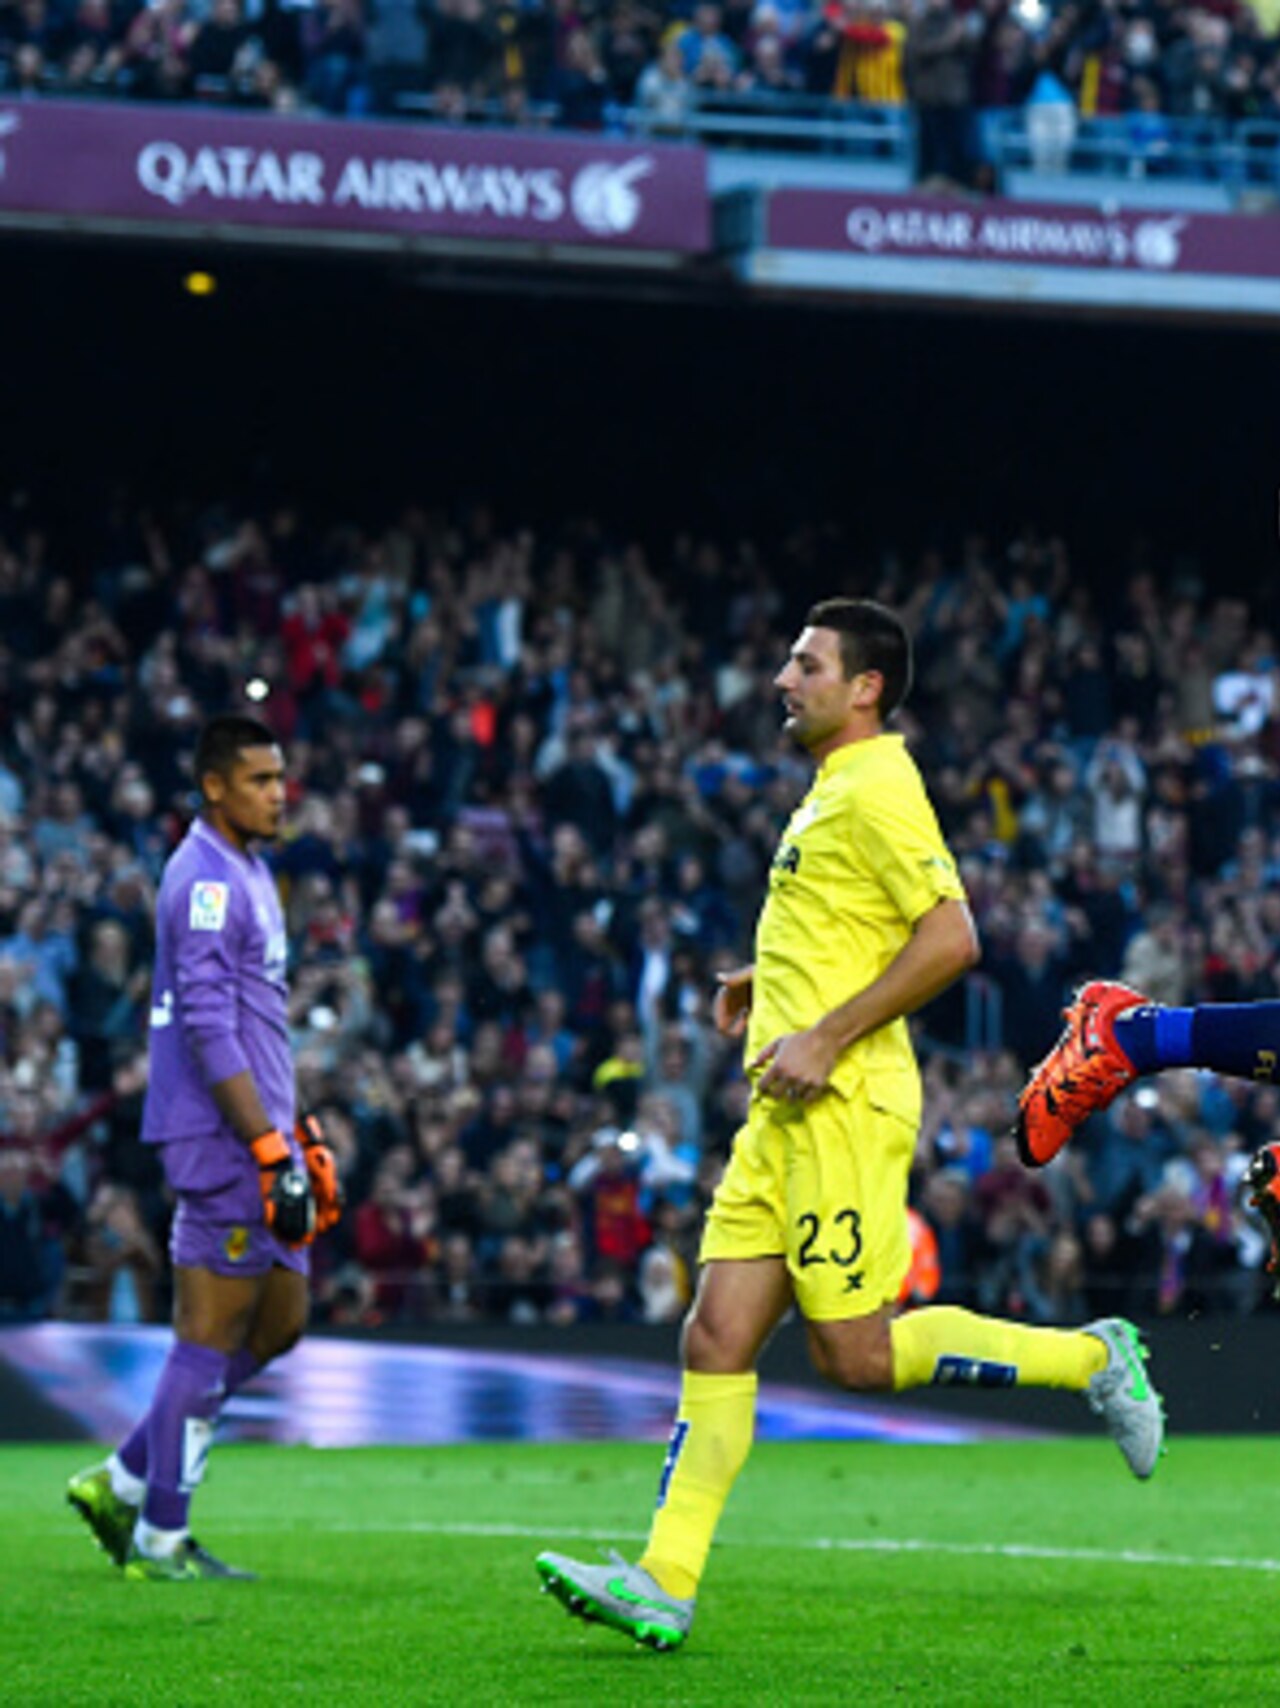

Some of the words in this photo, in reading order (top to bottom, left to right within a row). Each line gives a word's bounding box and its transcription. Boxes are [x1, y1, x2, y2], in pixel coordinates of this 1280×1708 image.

[137, 141, 326, 206] QATAR
[334, 156, 564, 222] AIRWAYS
[846, 206, 973, 254] QATAR
[978, 215, 1130, 264] AIRWAYS
[796, 1209, 862, 1269] 23
